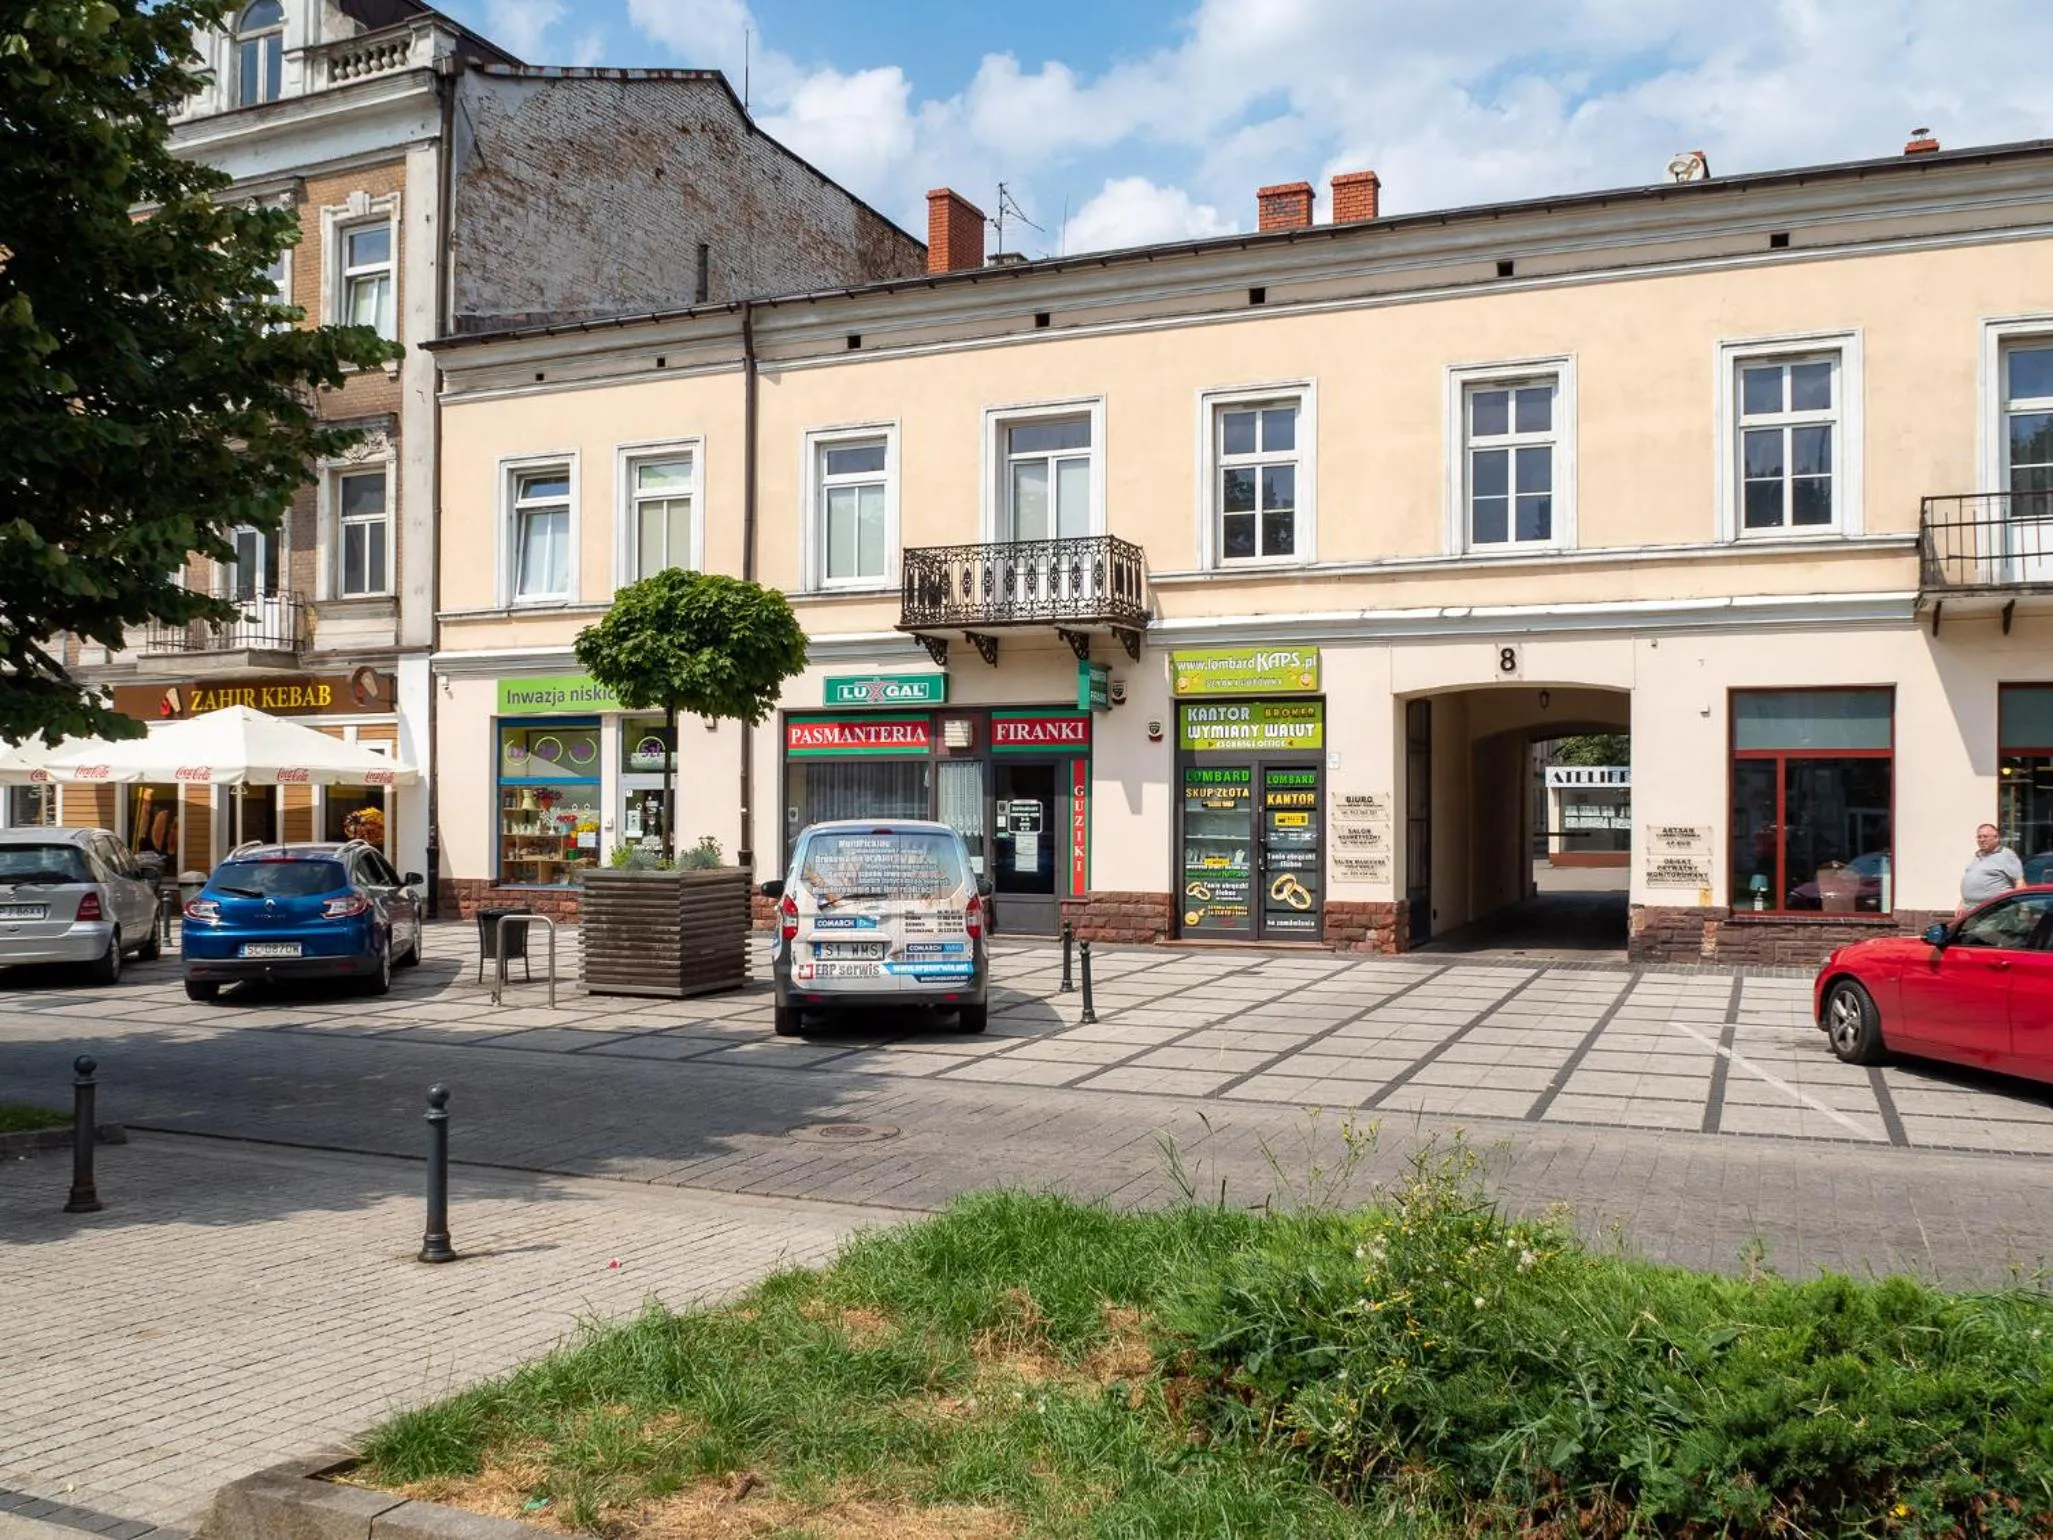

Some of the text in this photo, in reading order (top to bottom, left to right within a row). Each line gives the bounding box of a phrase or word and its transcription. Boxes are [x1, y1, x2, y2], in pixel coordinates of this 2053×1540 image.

[1500, 648, 1516, 671] 8
[191, 685, 331, 711] ZAHIR KEBAB
[507, 685, 617, 707] Inwazja niskic
[1187, 707, 1250, 721] KANTOR
[791, 726, 927, 745] PASMANTERIA
[996, 722, 1084, 741] FIRANKI
[1187, 724, 1260, 739] WYMIANY
[1186, 770, 1250, 782] LOMBARD
[1267, 775, 1315, 784] LOMBARD
[1185, 787, 1250, 798] SKUP ZŁOTA
[1267, 793, 1315, 805] KANTOR
[1074, 785, 1085, 872] GUZIKI
[817, 919, 854, 927] COMARCH
[852, 943, 878, 956] WMS
[815, 963, 880, 976] ERP serwis
